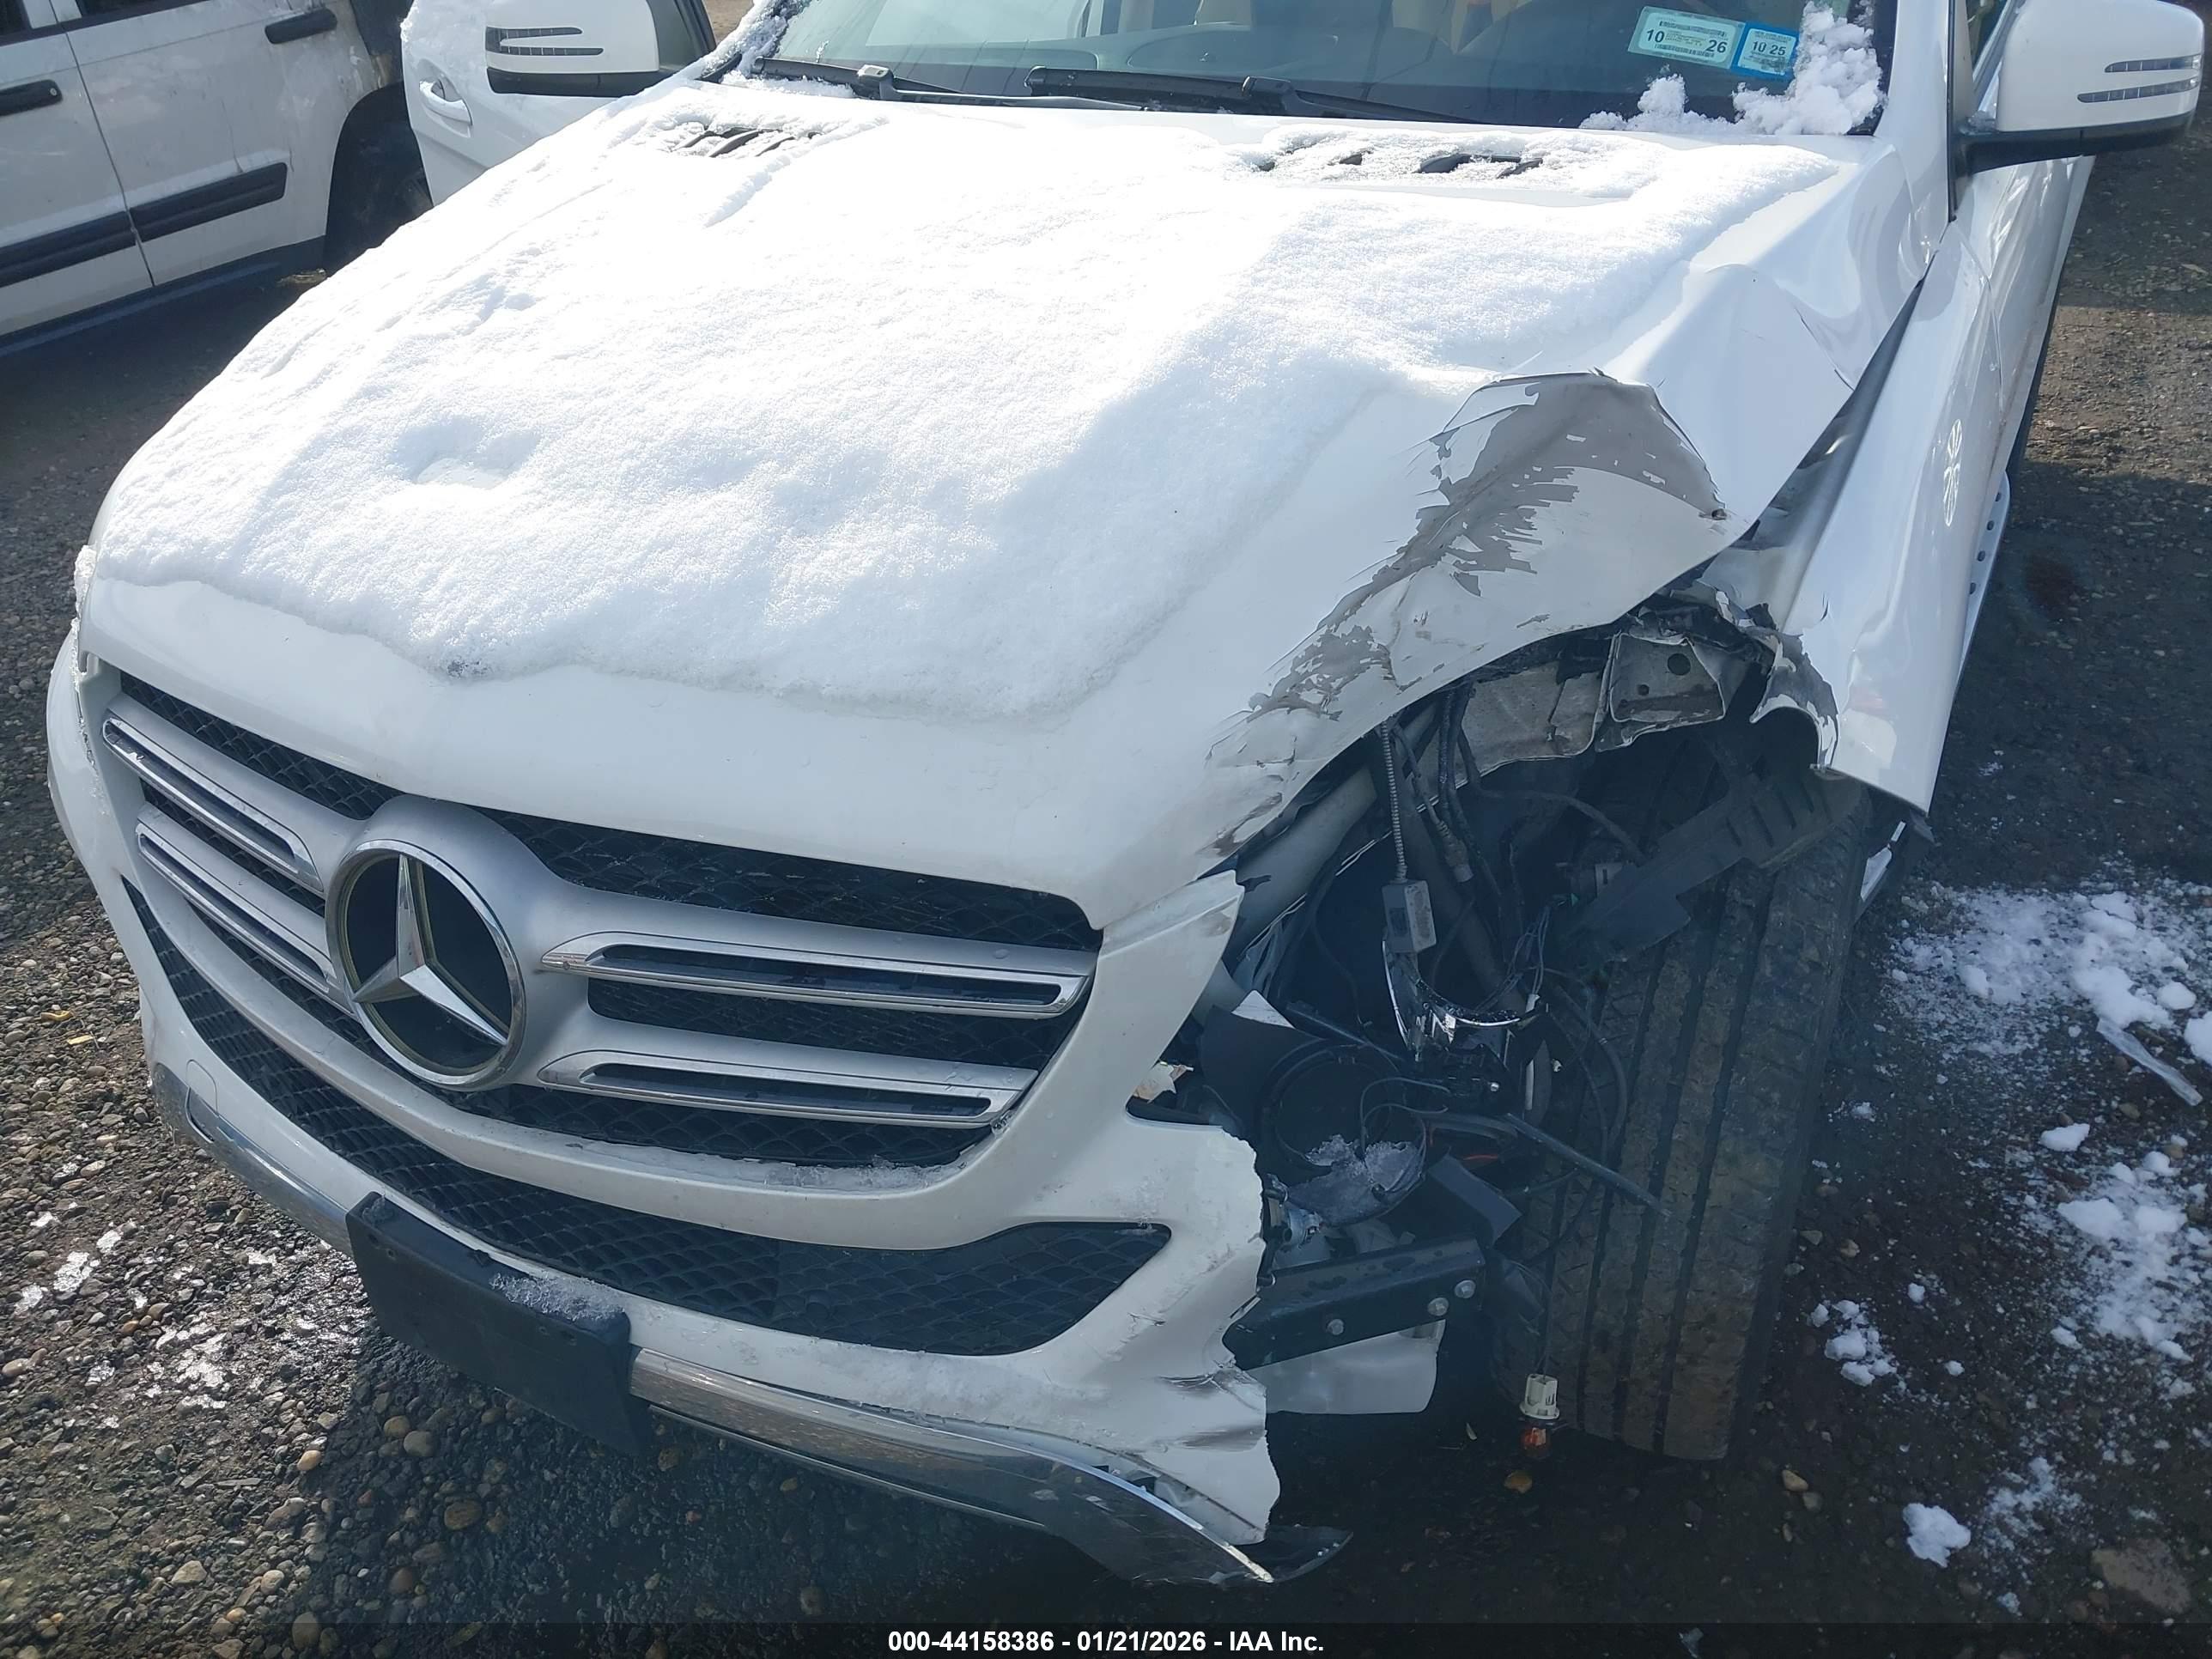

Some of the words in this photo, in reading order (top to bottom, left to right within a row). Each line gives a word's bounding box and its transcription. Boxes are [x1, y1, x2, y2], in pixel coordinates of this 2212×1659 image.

[1646, 29, 1665, 43] 10
[1705, 40, 1728, 53] 26
[1752, 40, 1766, 52] 10
[1769, 44, 1787, 56] 25
